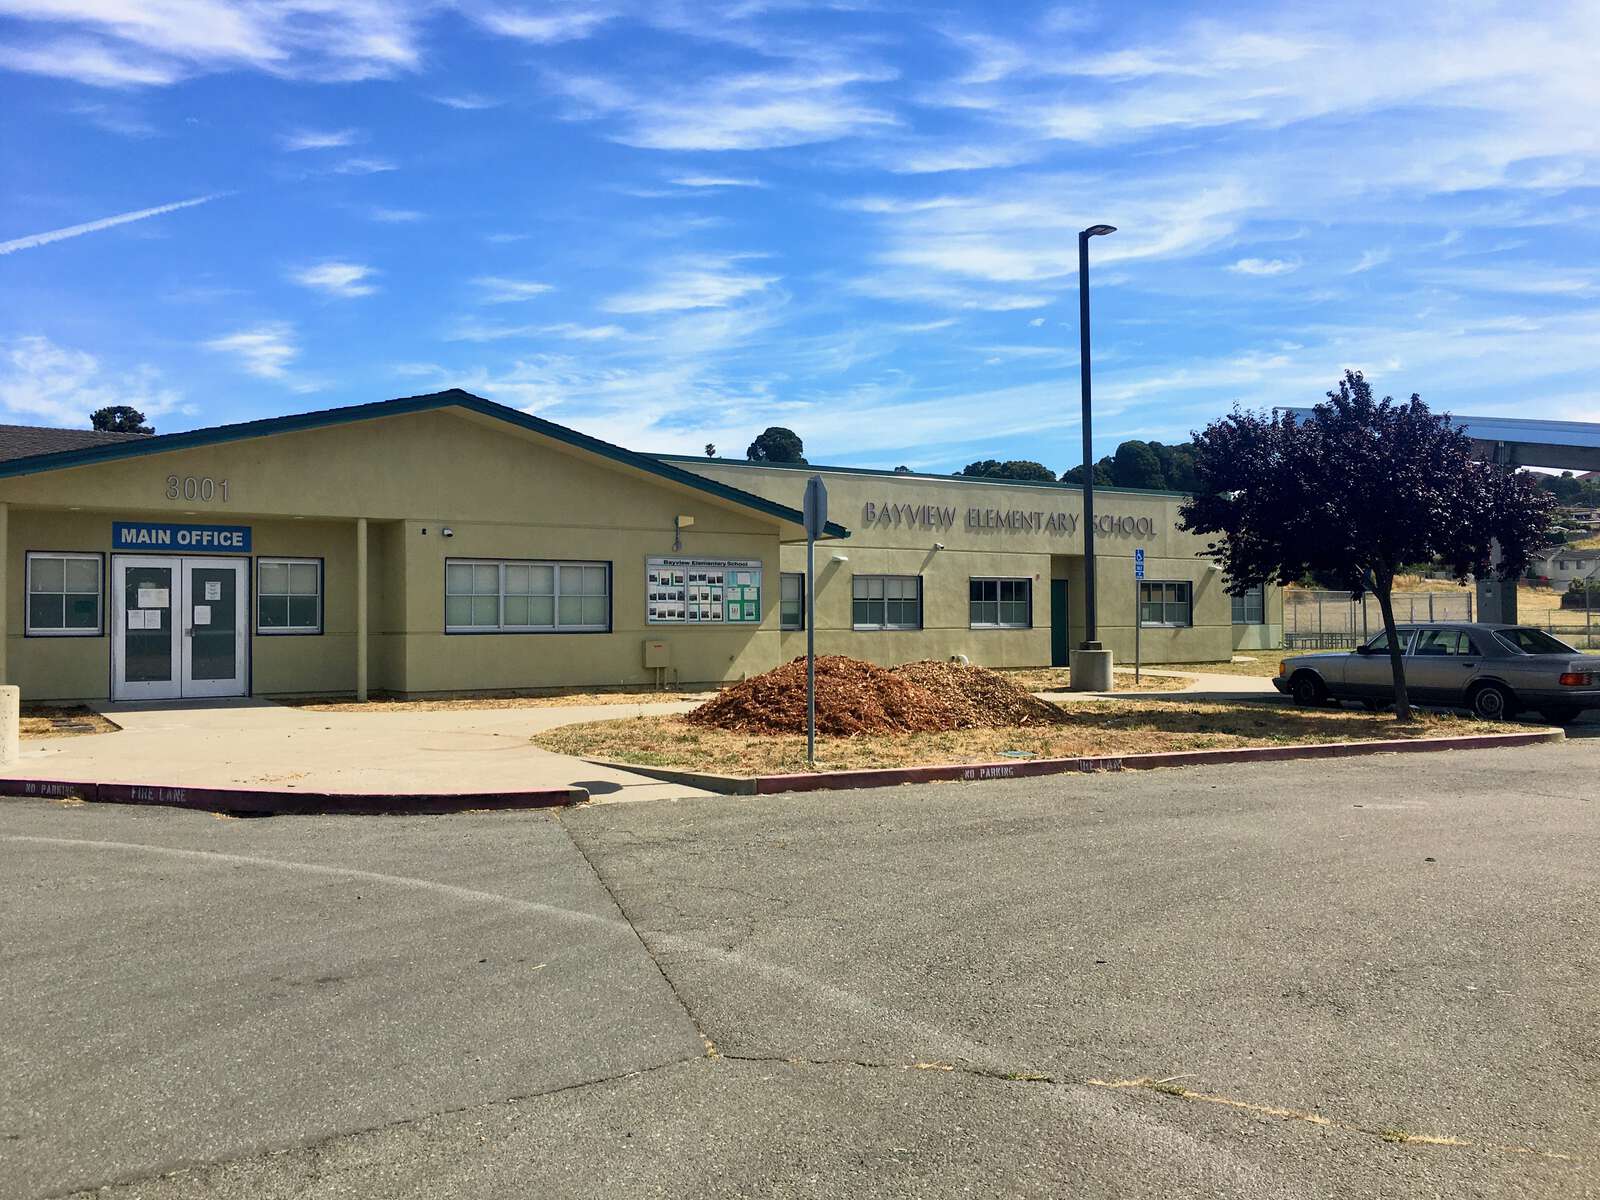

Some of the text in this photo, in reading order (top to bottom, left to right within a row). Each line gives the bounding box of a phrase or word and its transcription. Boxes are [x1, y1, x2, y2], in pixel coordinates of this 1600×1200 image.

[165, 474, 230, 501] 3001
[865, 502, 956, 526] BAYVIEW
[968, 507, 1079, 532] ELEMENTARY
[121, 528, 243, 546] MAIN OFFICE
[964, 766, 1014, 779] NO PARKING
[25, 783, 36, 794] NO
